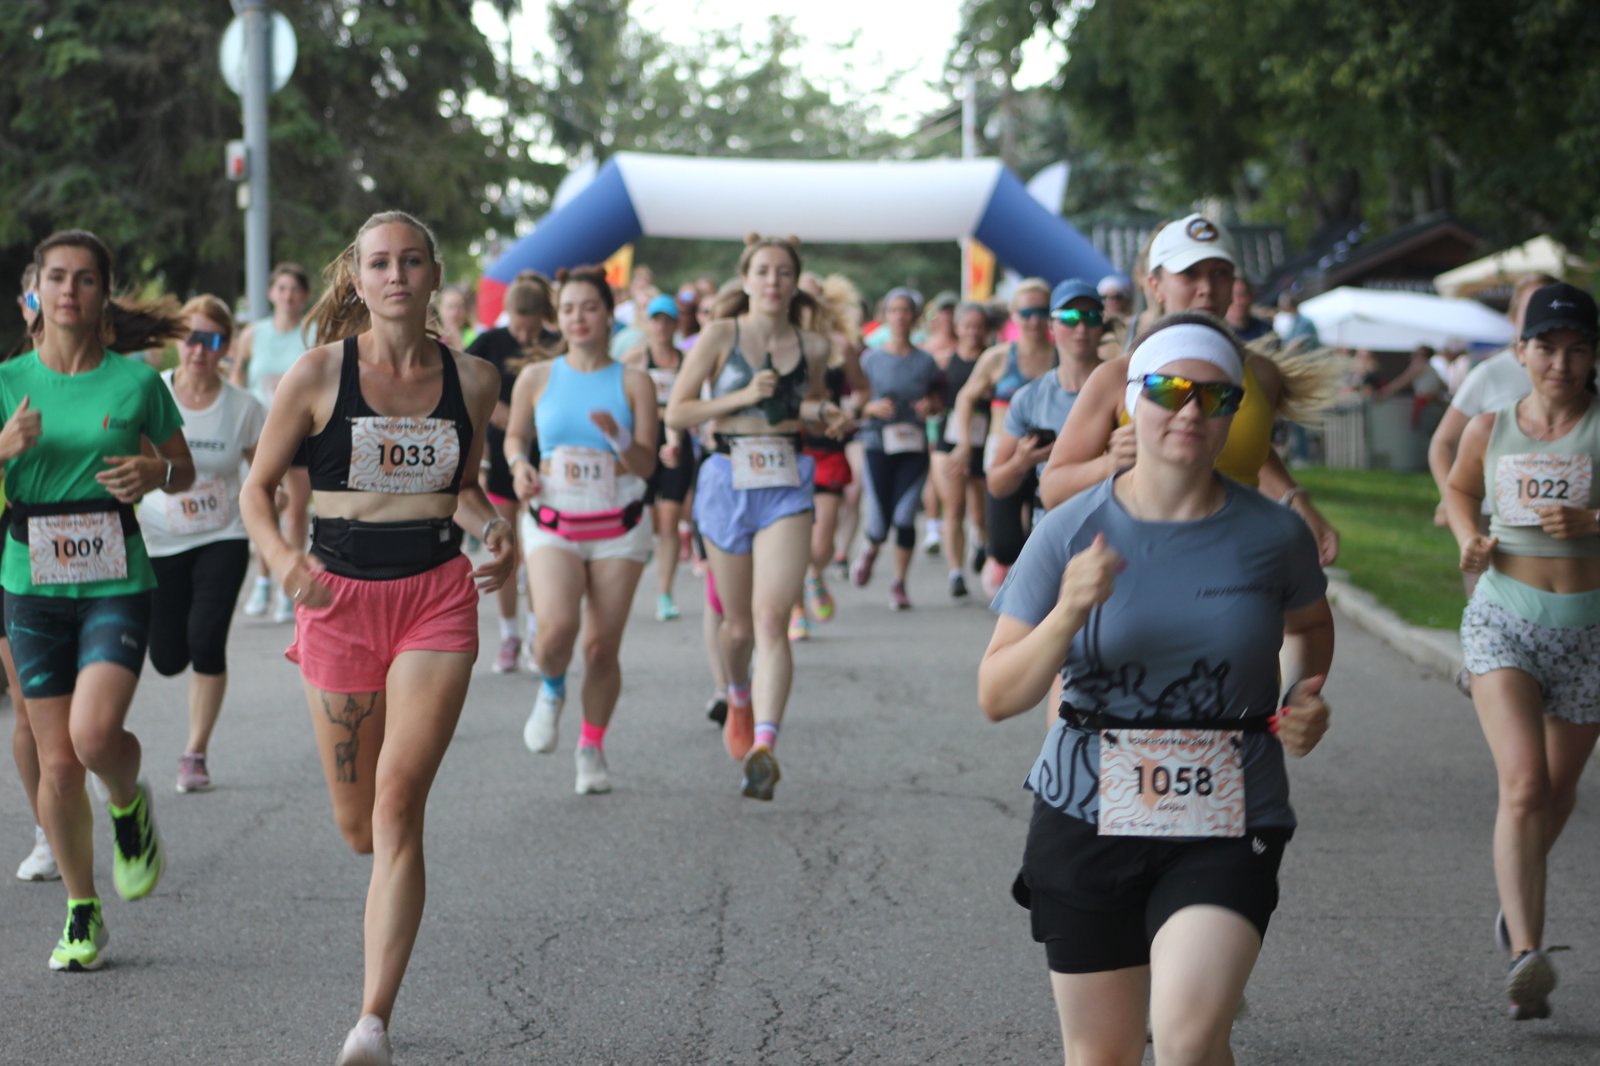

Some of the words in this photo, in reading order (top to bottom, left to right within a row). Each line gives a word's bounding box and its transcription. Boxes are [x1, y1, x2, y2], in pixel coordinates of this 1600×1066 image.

[377, 444, 436, 466] 1033
[1516, 478, 1569, 500] 1022
[182, 496, 218, 514] 1010
[52, 537, 104, 558] 1009
[1133, 765, 1213, 796] 1058
